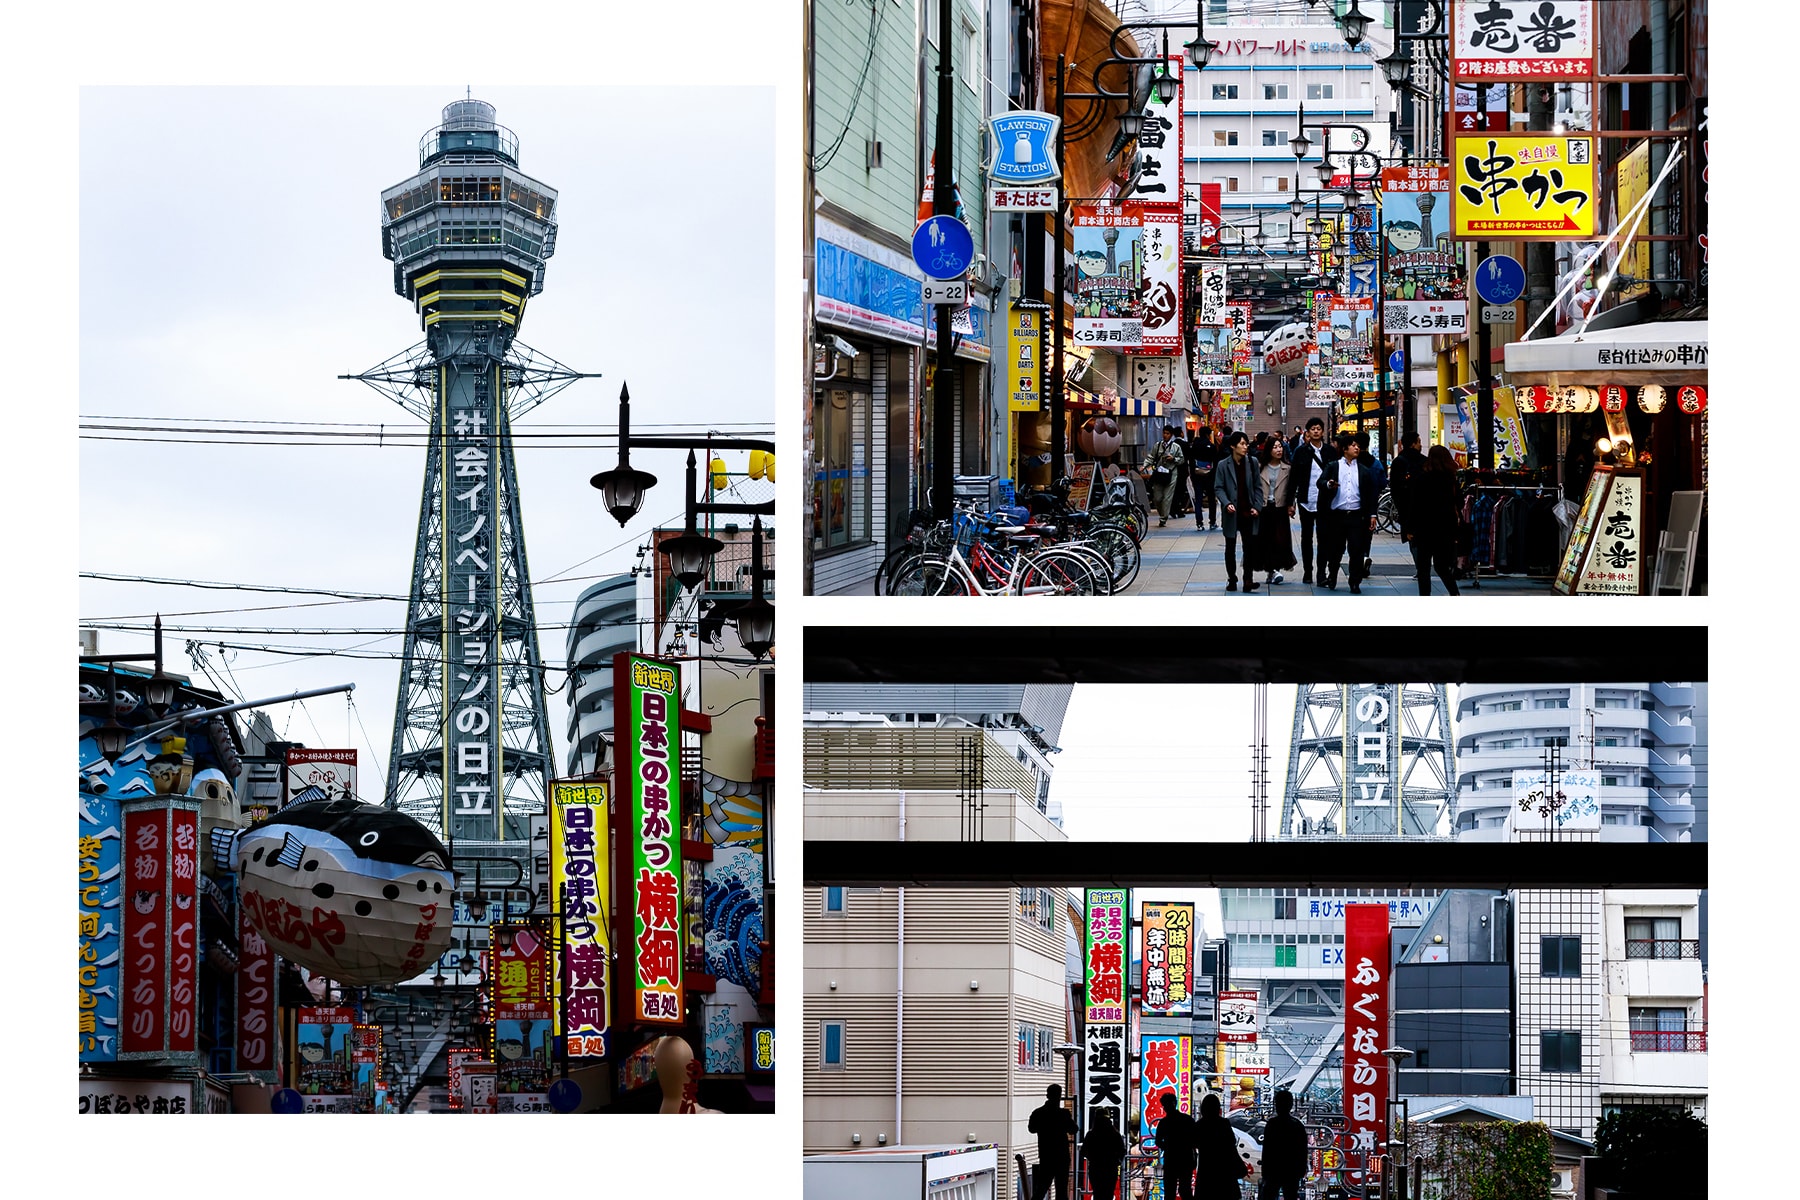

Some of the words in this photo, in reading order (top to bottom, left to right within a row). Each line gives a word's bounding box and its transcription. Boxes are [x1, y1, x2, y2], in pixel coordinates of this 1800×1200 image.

[1208, 39, 1306, 56] スパワールド
[1458, 60, 1588, 75] 2階お座敷もございます。
[998, 121, 1047, 132] LAWSON
[999, 161, 1047, 173] STATION
[1518, 144, 1559, 161] 味自慢
[1407, 168, 1439, 179] 通天閣
[1459, 140, 1589, 215] 串かつ
[1151, 227, 1163, 261] 串かつ
[1013, 329, 1039, 337] BILLIARDS
[1074, 330, 1122, 342] くら寿司
[1229, 308, 1246, 345] 串かつ
[1408, 314, 1466, 328] くら寿司
[1018, 361, 1034, 369] DARTS
[1345, 371, 1374, 379] くら寿司
[1607, 387, 1620, 410] 日本酒
[453, 409, 492, 816] 社会イノベーションの日立
[633, 663, 675, 693] 新世界
[1355, 692, 1391, 808] の日立
[641, 691, 670, 866] 日本一の串かつ
[555, 786, 604, 805] 新世界
[134, 823, 160, 881] 名物
[174, 822, 195, 881] 名物
[564, 807, 597, 940] 日本一の串かつ
[1090, 890, 1124, 905] 新世界
[636, 868, 680, 988] 横綱
[1090, 906, 1107, 941] 串かつ
[1107, 906, 1123, 941] 日本一の
[1146, 927, 1167, 1006] 年中無休
[1165, 909, 1191, 1002] 24時間営業
[1322, 948, 1344, 964] EX
[556, 943, 606, 1033] 横綱
[1088, 942, 1123, 1005] 横綱
[644, 991, 678, 1019] 酒処
[1088, 1006, 1123, 1021] 通天閣店
[1087, 1025, 1124, 1040] 大相撲
[757, 1031, 772, 1067] 新世界
[1181, 1037, 1190, 1069] 新世界
[1181, 1071, 1190, 1114] 日本一の
[303, 1105, 337, 1113] ら寿司
